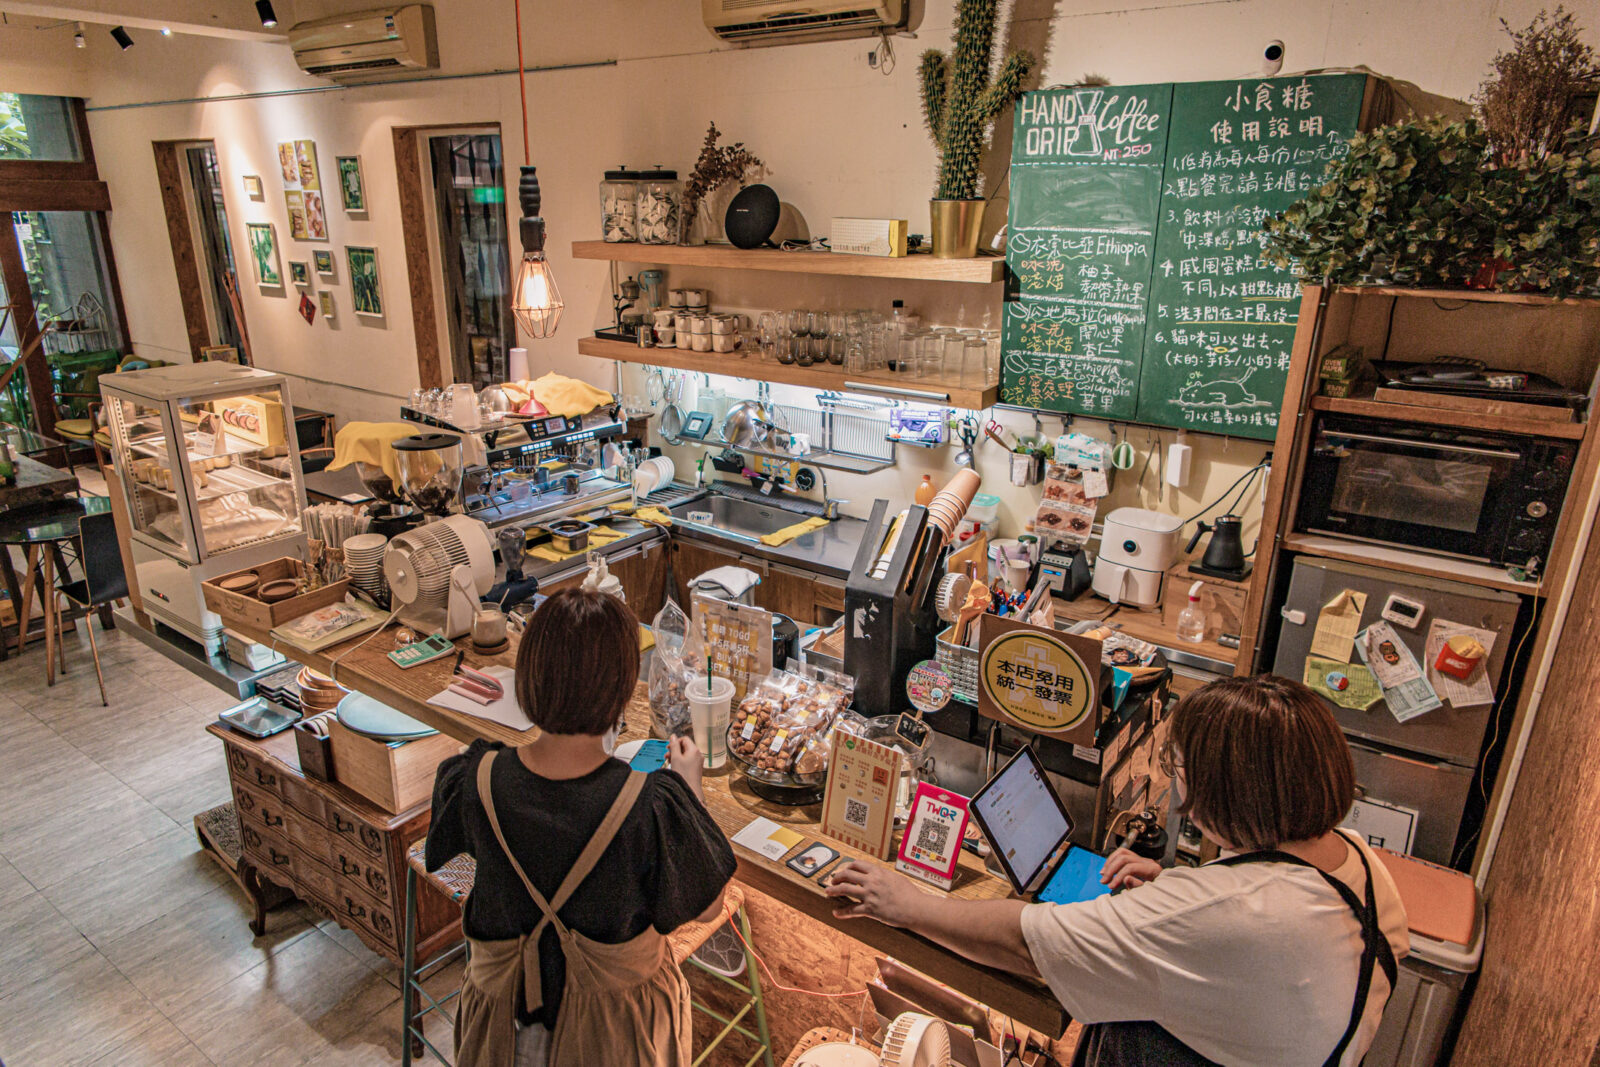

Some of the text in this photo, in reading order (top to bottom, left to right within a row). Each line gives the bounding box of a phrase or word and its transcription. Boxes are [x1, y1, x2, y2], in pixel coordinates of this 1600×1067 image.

[1021, 94, 1077, 125] HAND
[1225, 78, 1314, 112] 小食糖
[1098, 95, 1160, 144] Coffee
[1210, 116, 1323, 144] 使用說明
[1026, 127, 1079, 155] DRIP
[1097, 235, 1147, 265] Ethiopia
[1026, 260, 1064, 271] 水洗
[1078, 264, 1114, 280] 柚子
[996, 674, 1073, 706] 統一發票
[997, 660, 1074, 691] 本店免用
[926, 801, 957, 821] TWQR
